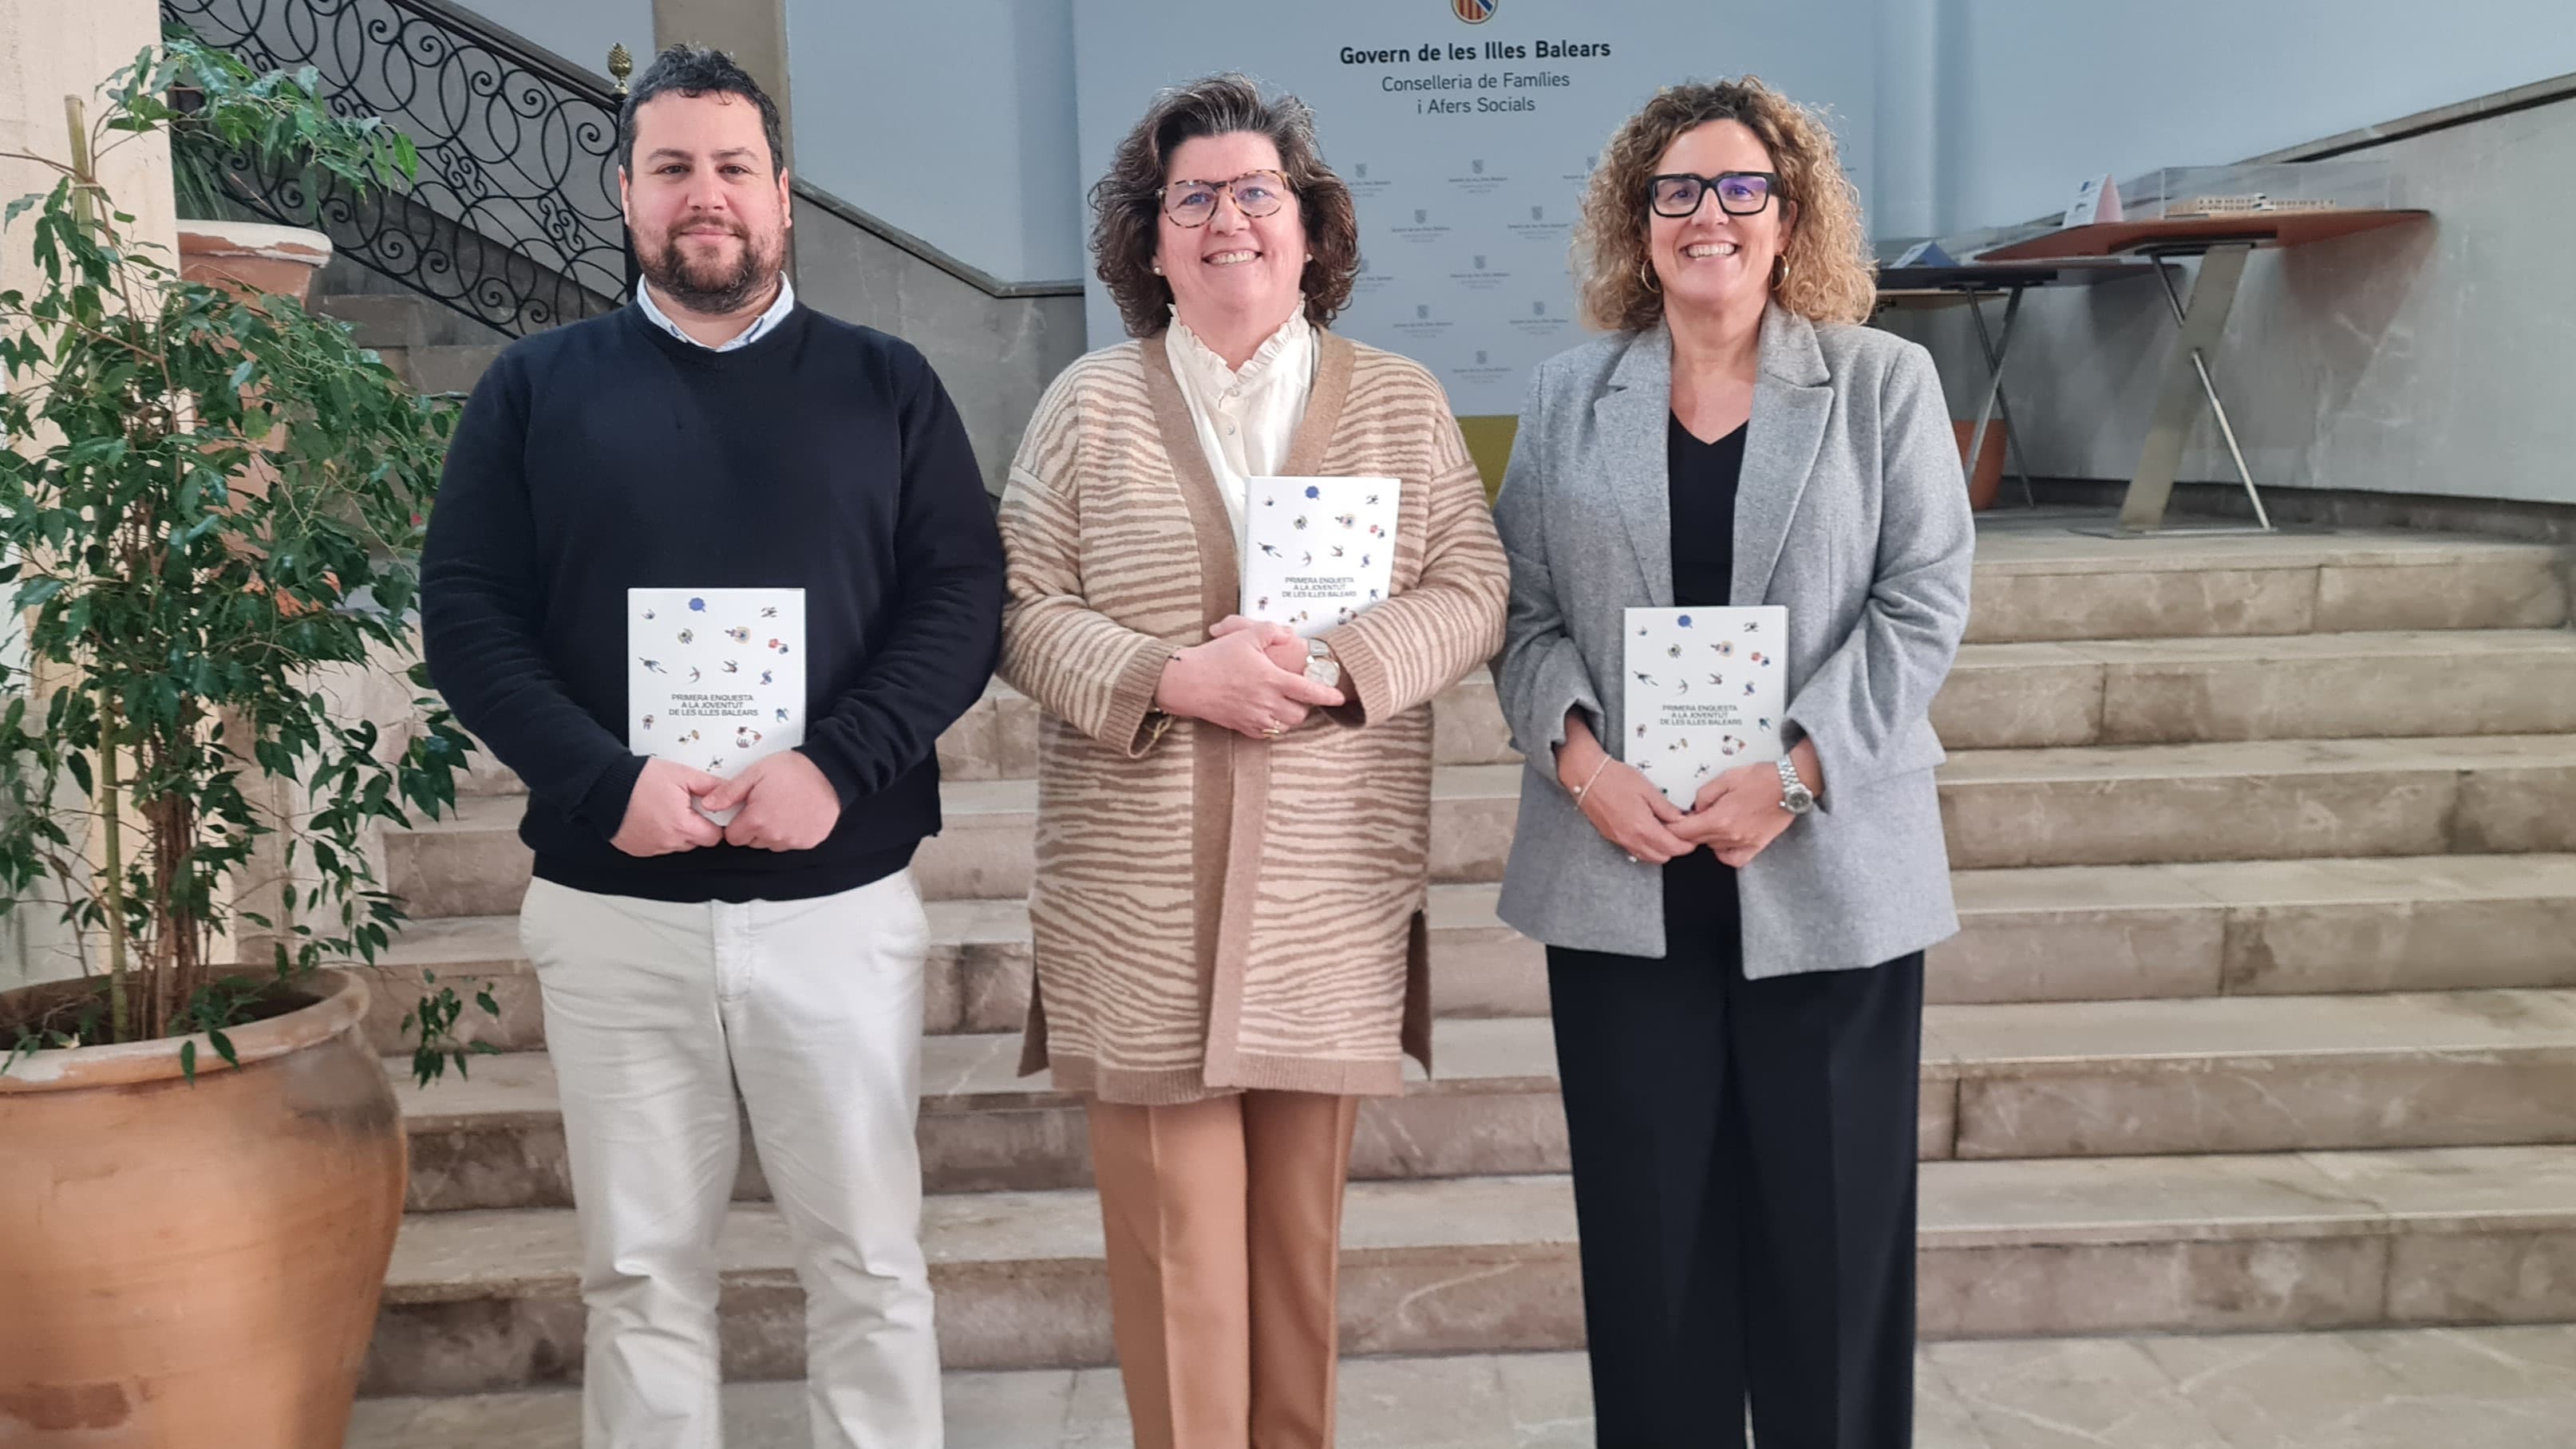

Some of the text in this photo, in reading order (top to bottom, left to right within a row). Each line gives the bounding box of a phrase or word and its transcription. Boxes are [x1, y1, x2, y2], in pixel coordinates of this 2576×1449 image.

[1340, 39, 1611, 64] Govern de les Illes Balears
[1382, 72, 1570, 92] Conselleria de Famílies
[1417, 97, 1535, 113] i Afers Socials
